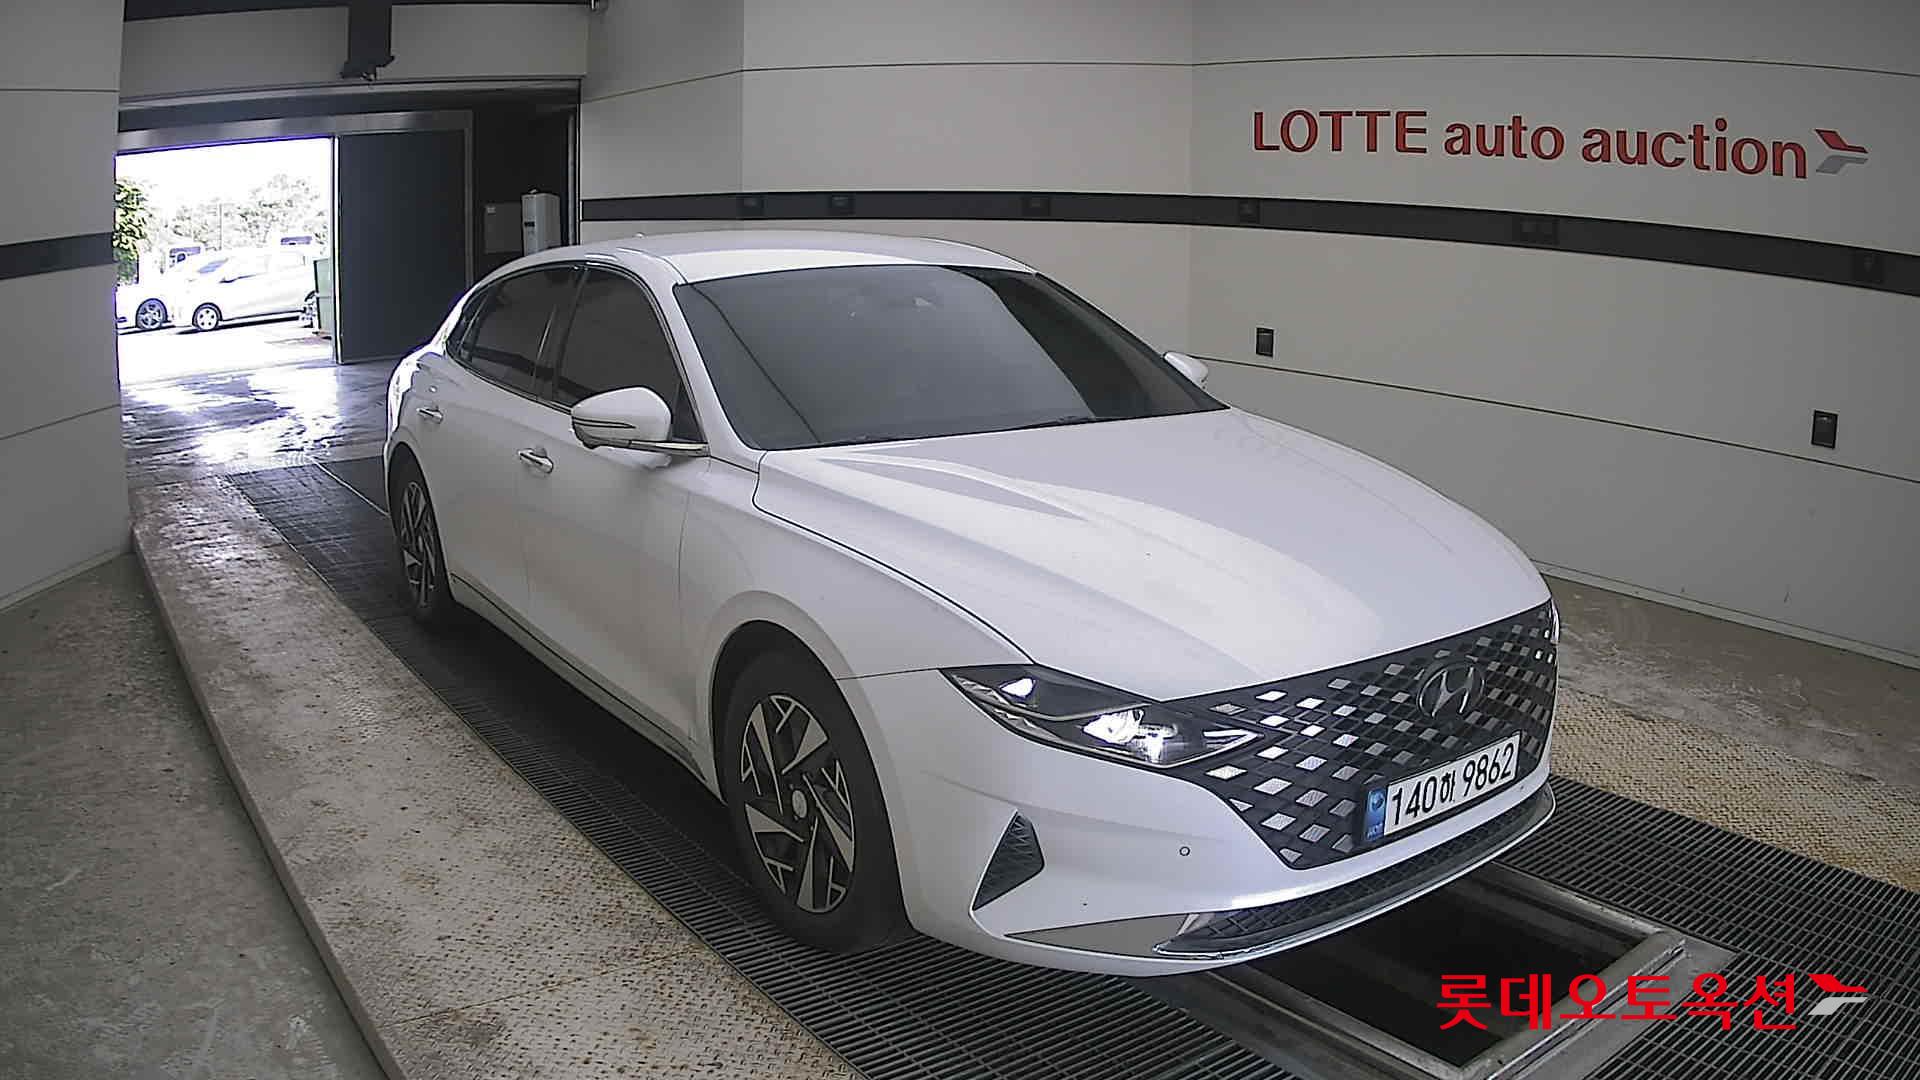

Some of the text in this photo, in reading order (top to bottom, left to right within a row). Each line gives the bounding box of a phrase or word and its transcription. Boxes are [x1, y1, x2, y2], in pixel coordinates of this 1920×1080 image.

[1253, 110, 1808, 180] LOTTE auto auction
[1392, 742, 1515, 826] 140하 9862
